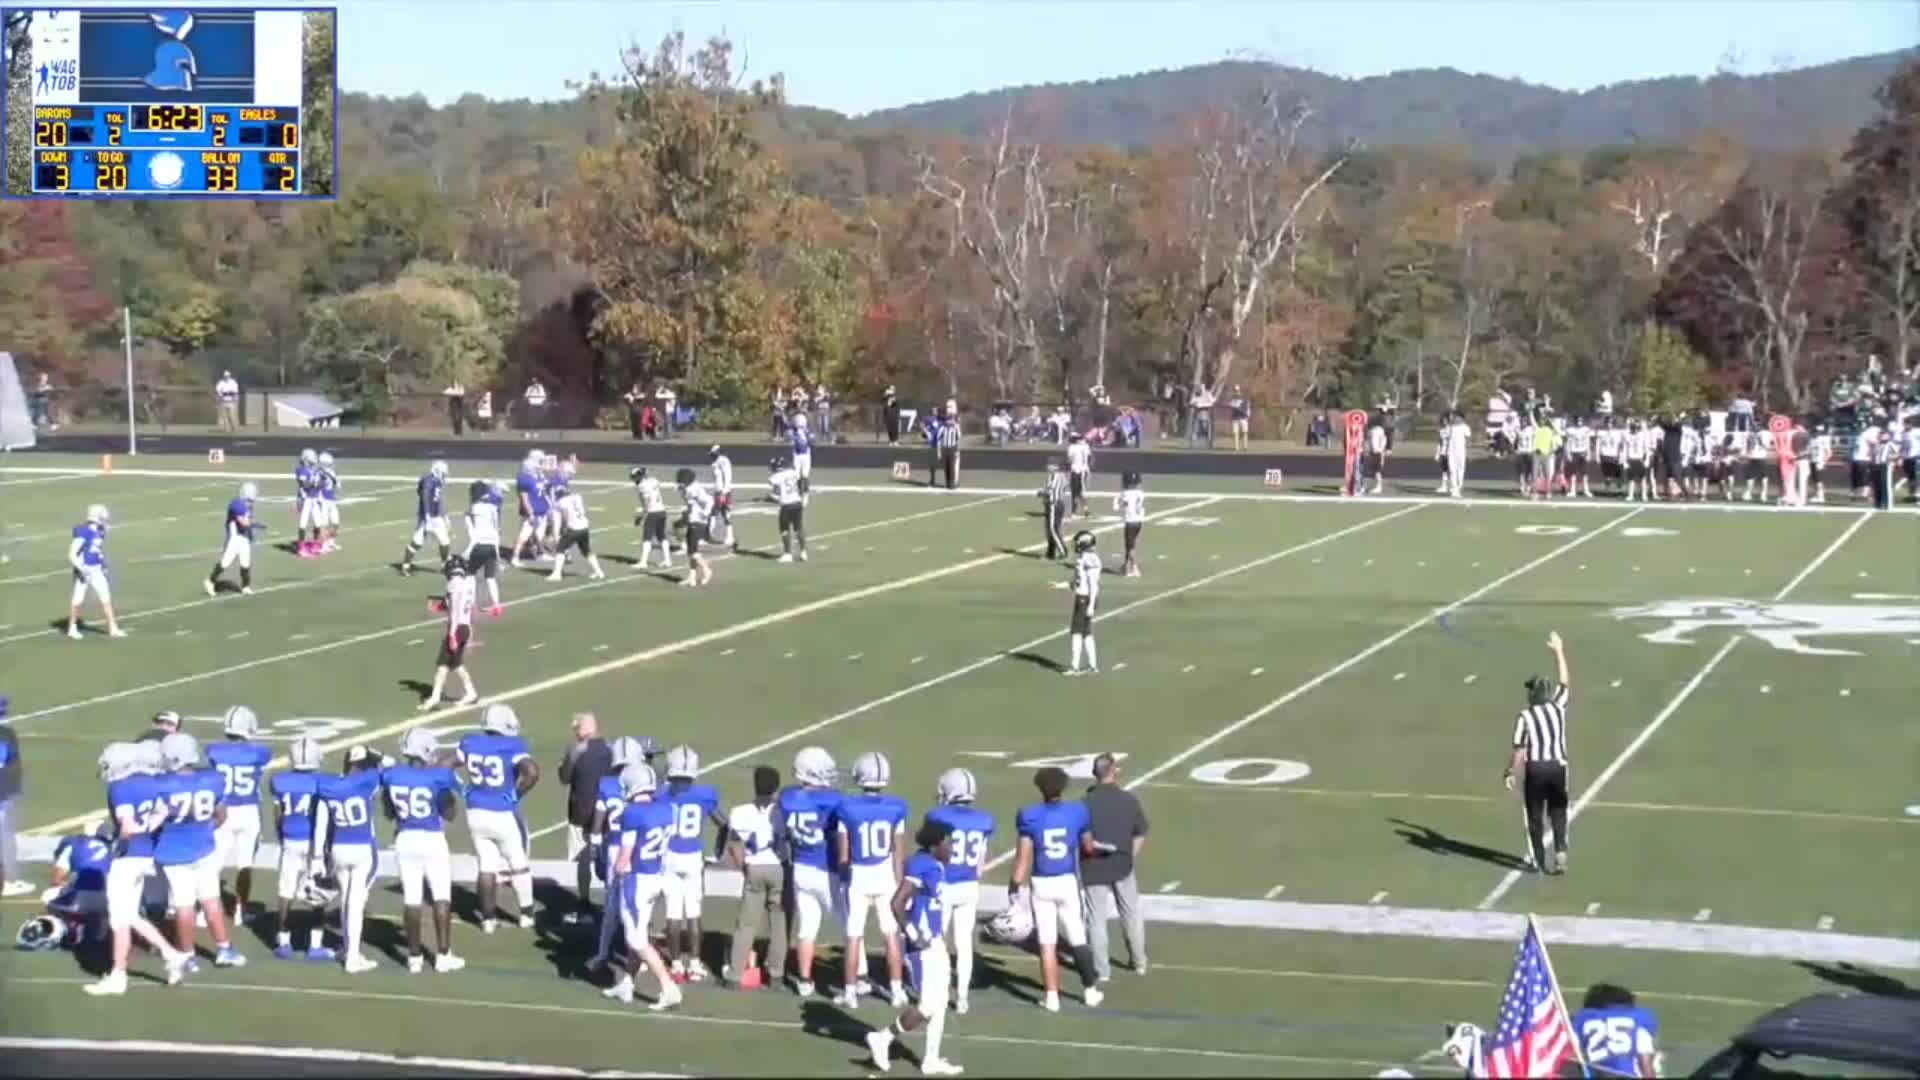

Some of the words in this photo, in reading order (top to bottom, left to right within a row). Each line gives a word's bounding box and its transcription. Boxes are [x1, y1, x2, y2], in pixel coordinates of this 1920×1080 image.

[467, 754, 506, 787] 53
[171, 790, 215, 824] 78
[281, 791, 312, 816] 14
[389, 785, 433, 819] 56
[858, 820, 892, 858] 10
[950, 829, 984, 867] 33
[1044, 828, 1068, 860] 5
[1582, 1016, 1635, 1061] 25
